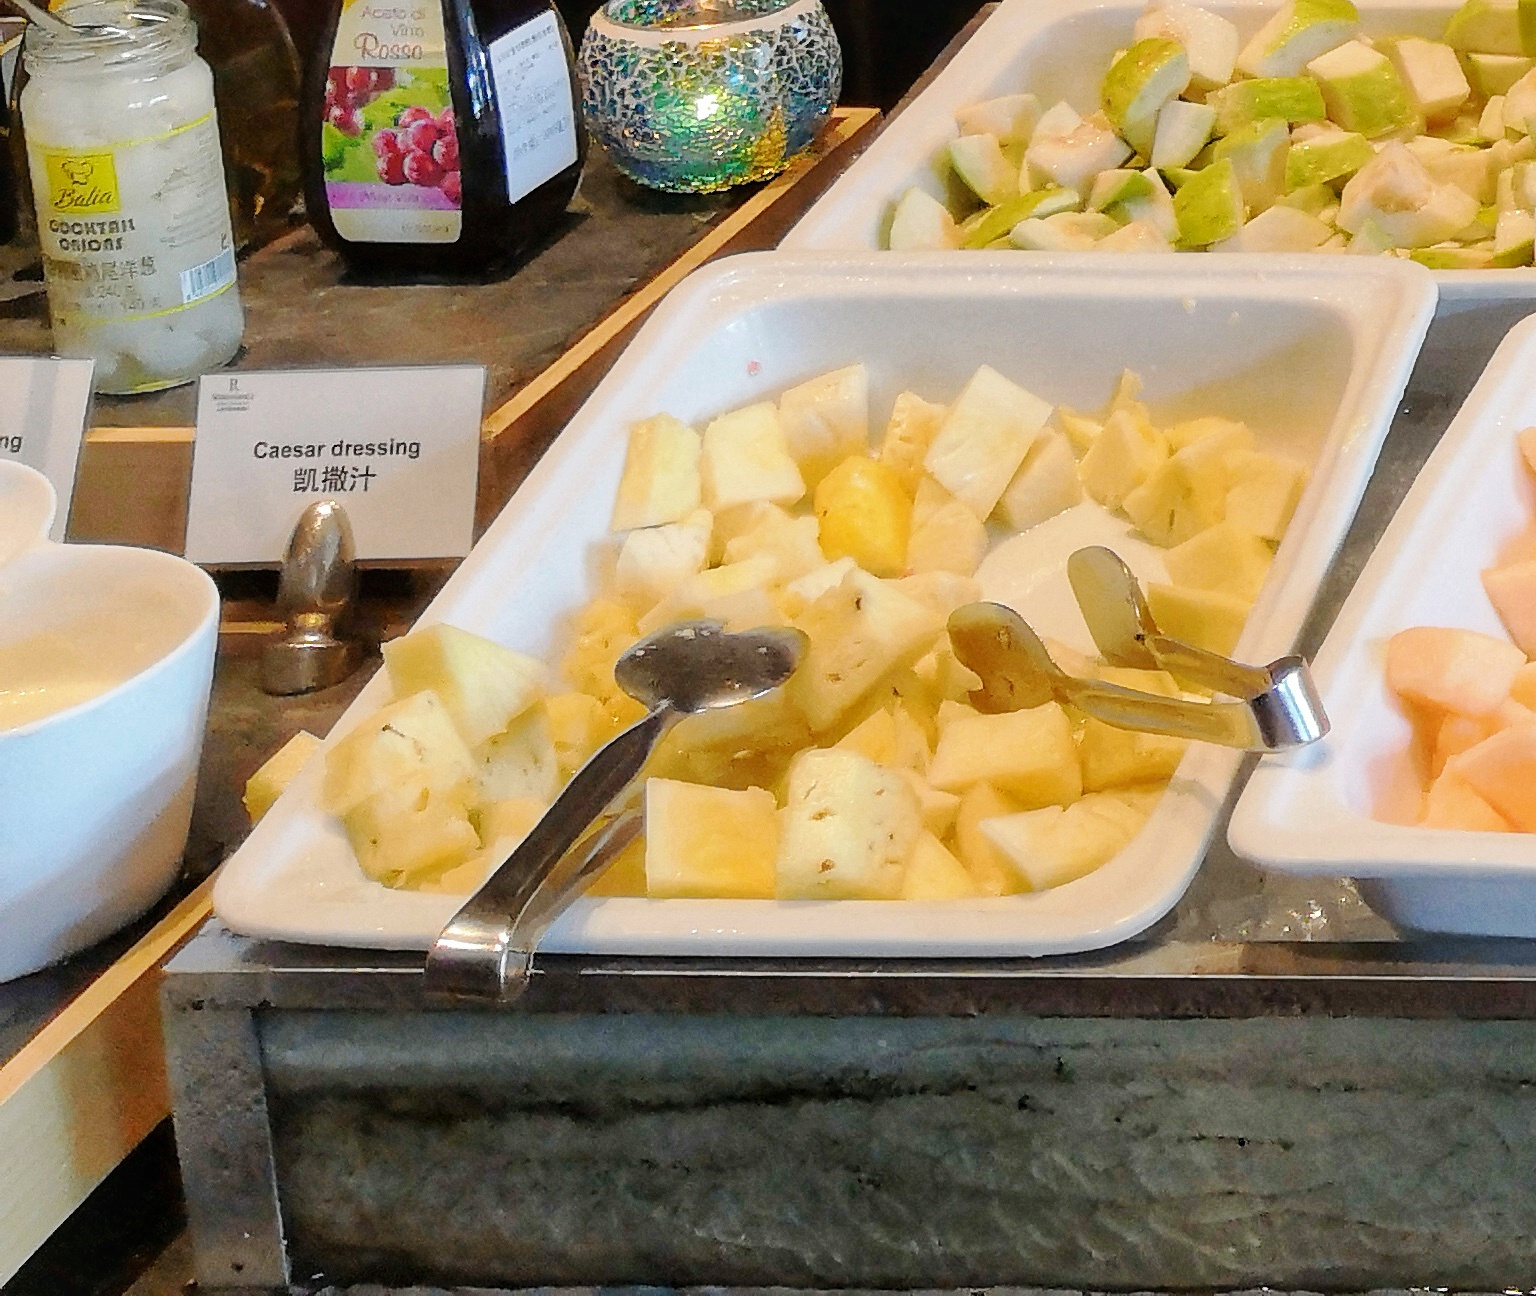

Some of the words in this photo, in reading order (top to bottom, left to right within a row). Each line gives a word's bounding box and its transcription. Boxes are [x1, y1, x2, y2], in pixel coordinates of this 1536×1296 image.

[353, 32, 423, 60] Rosso
[53, 185, 114, 210] Balia
[49, 217, 136, 236] COCKTAIL
[57, 236, 124, 253] ONIONS
[253, 440, 327, 459] Caesar
[330, 438, 421, 459] dressing
[292, 465, 377, 493] 凯撒汁
